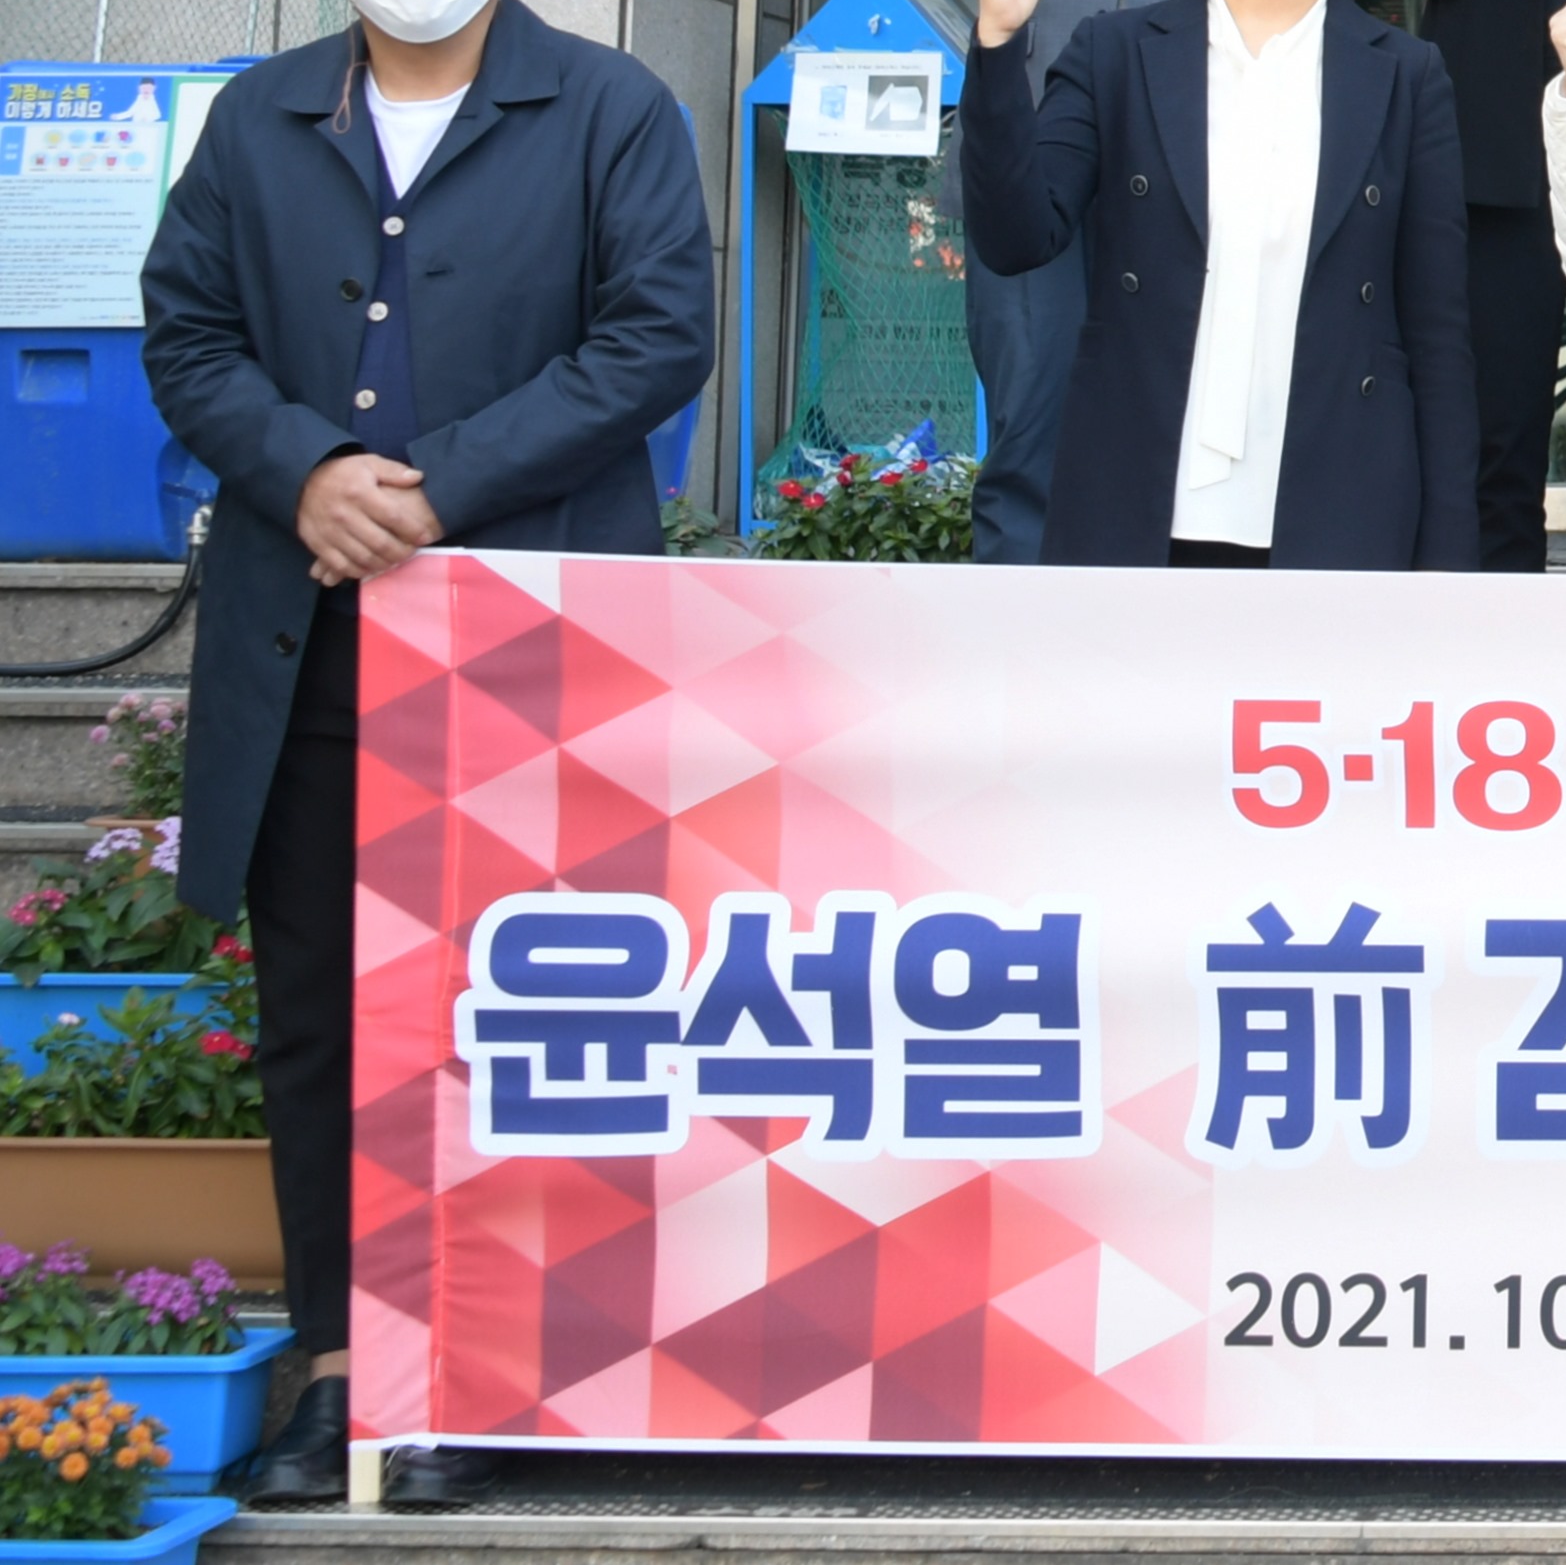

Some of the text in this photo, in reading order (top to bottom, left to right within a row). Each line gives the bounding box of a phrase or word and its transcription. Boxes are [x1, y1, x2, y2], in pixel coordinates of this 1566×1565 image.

[1232, 700, 1563, 831] 5·18
[474, 910, 1082, 1142] 윤석열
[1205, 903, 1425, 1150] 前
